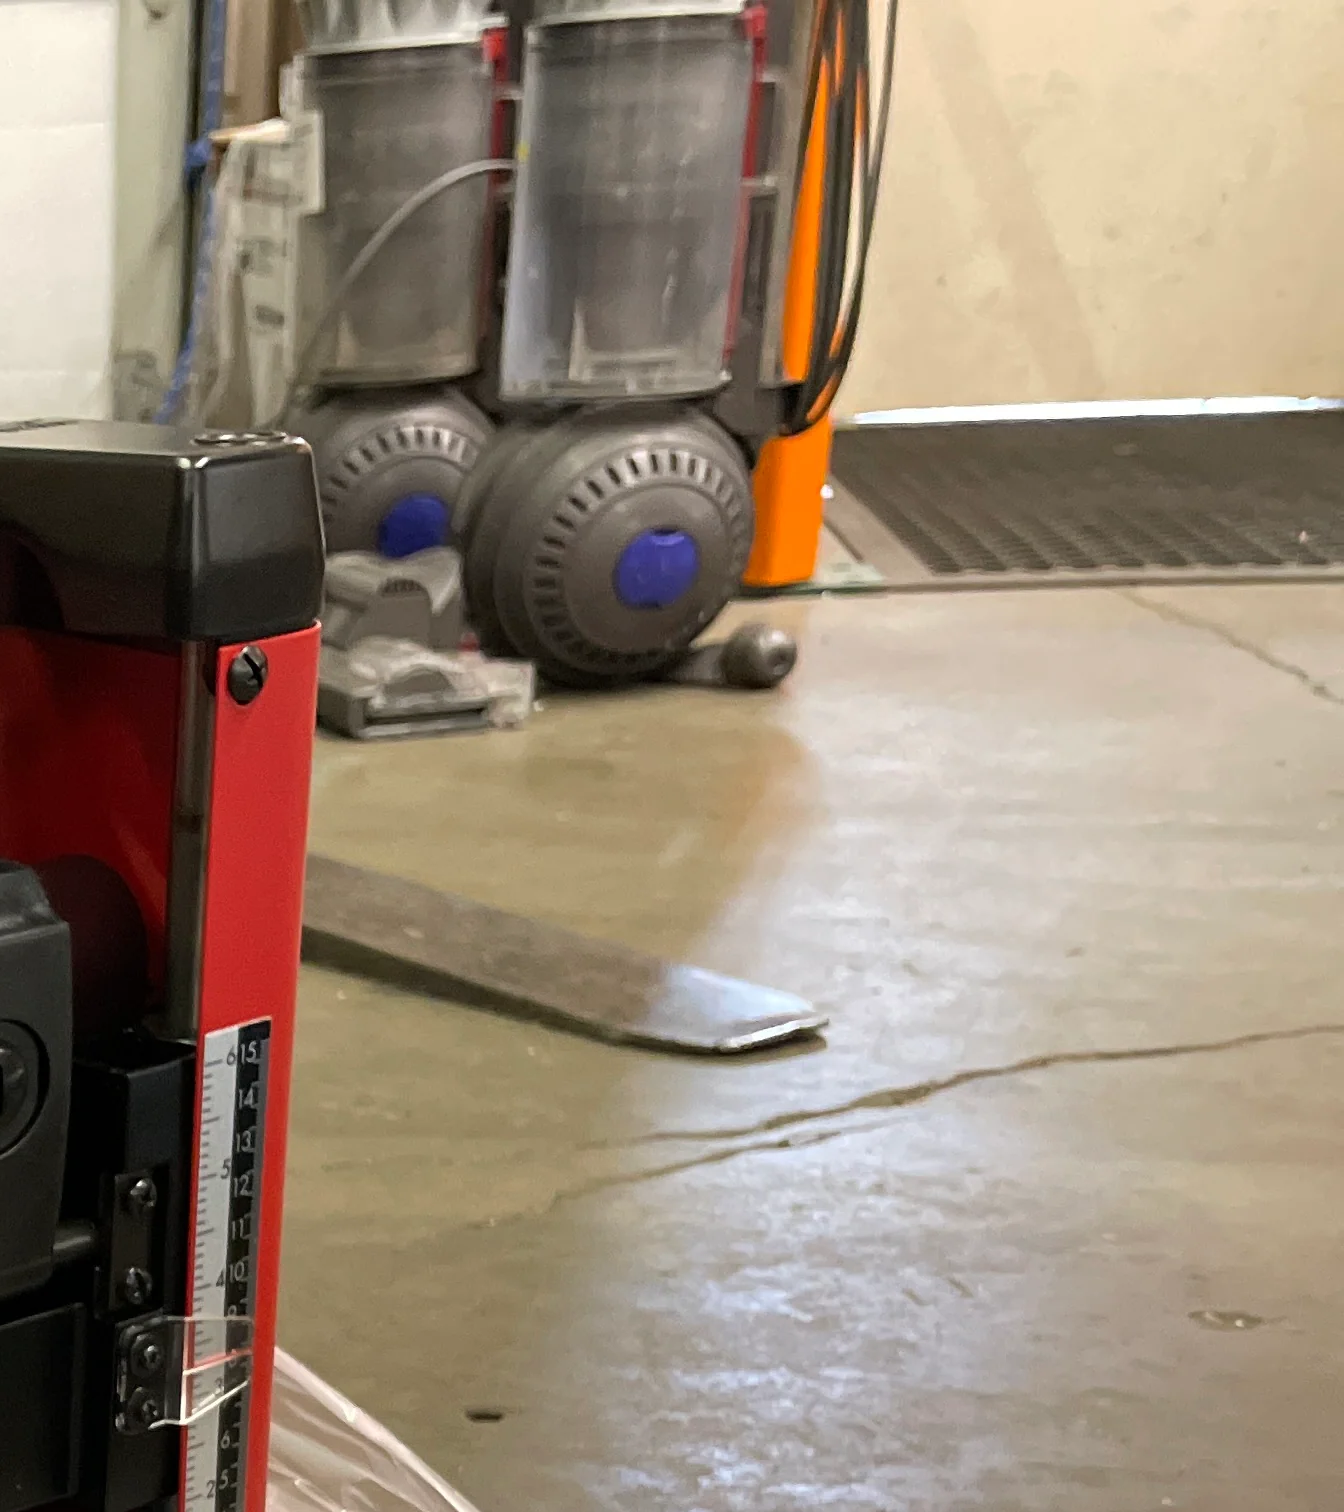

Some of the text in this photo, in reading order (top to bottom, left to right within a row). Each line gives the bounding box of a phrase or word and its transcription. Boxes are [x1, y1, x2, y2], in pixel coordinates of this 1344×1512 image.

[226, 1045, 236, 1067] 6
[240, 1040, 257, 1065] 15
[238, 1086, 255, 1110] 14
[236, 1130, 252, 1154] 13
[220, 1158, 231, 1180] 5
[233, 1174, 249, 1198] 12
[231, 1218, 244, 1241] 11
[215, 1269, 225, 1288] 4
[228, 1261, 245, 1284] 10
[220, 1433, 231, 1450] 6
[206, 1479, 217, 1500] 2
[218, 1468, 230, 1490] 5
